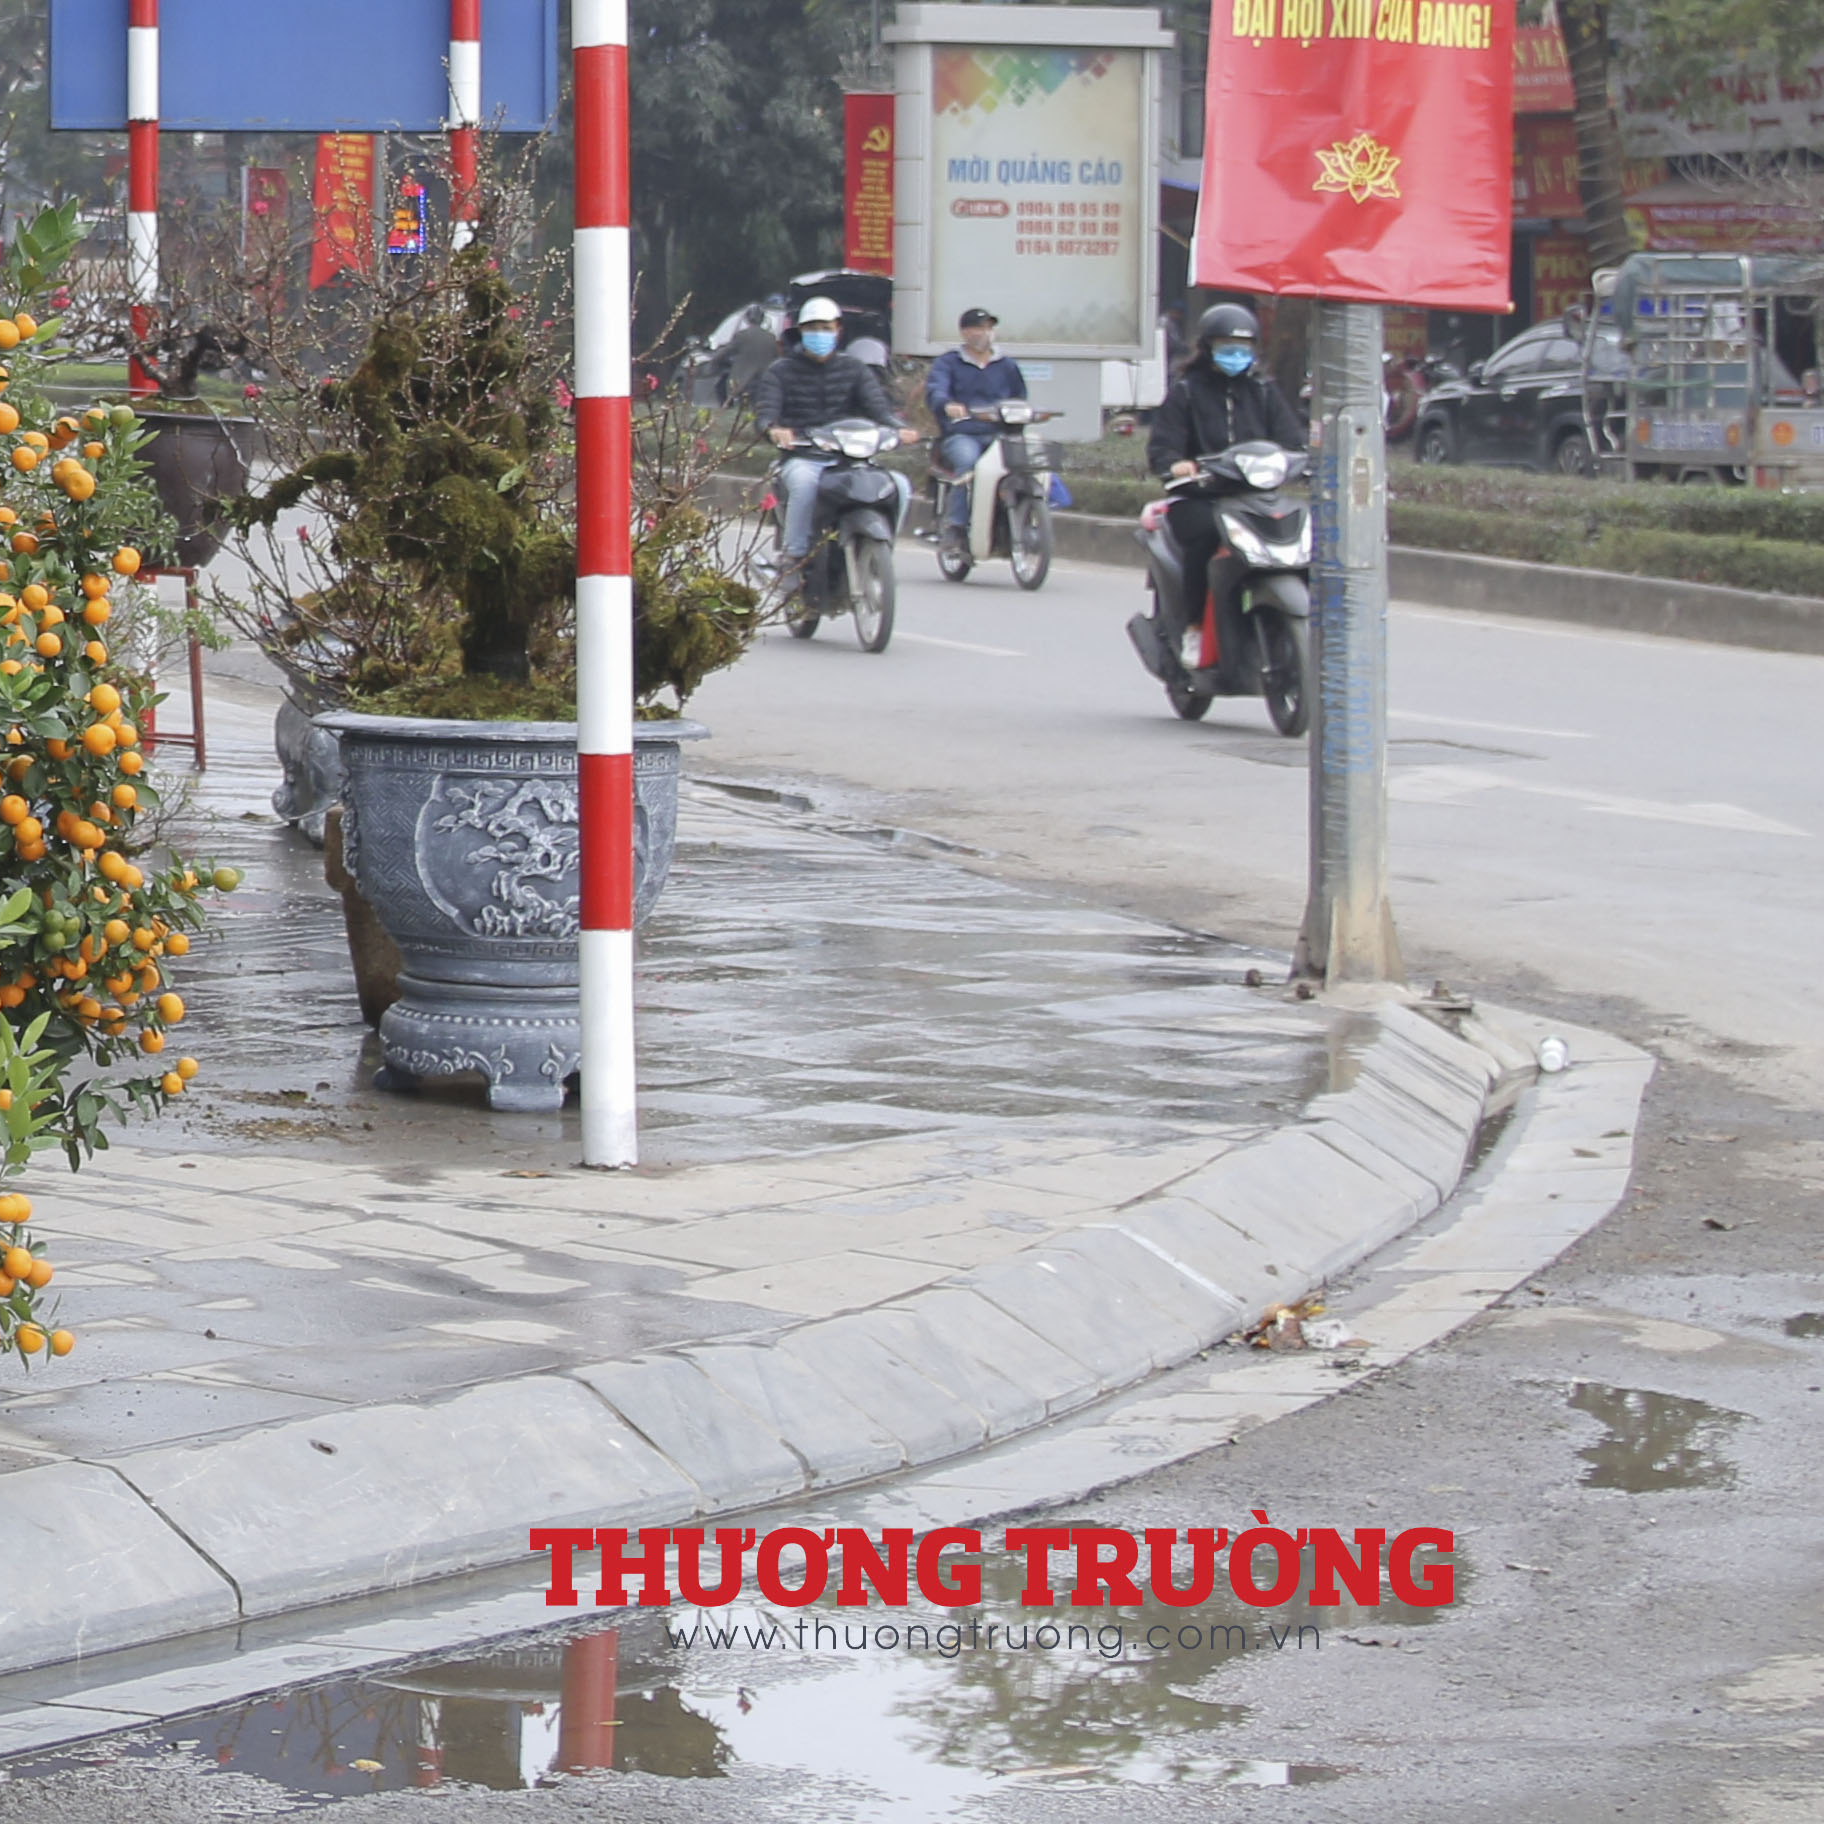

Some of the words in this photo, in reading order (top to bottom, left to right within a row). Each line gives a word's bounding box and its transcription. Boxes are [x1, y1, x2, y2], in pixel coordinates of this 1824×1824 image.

[947, 154, 990, 183] MỜI
[997, 152, 1072, 186] QUẢNG
[1079, 157, 1123, 185] CÁO
